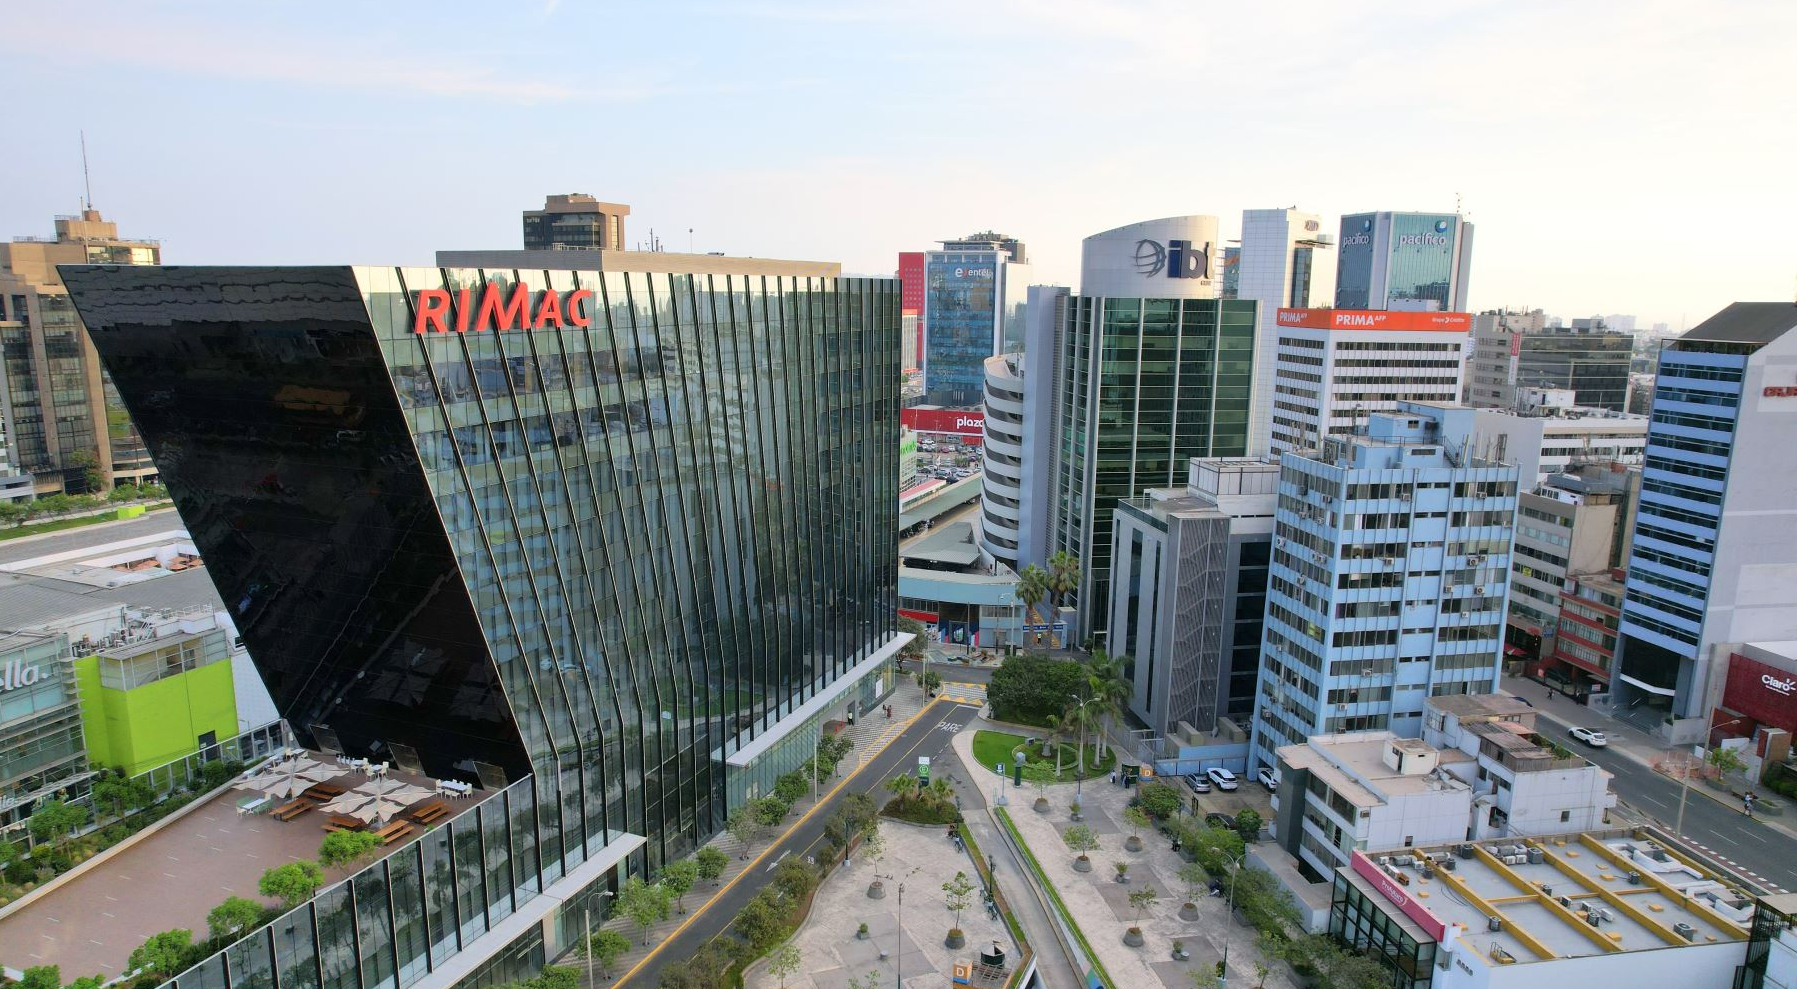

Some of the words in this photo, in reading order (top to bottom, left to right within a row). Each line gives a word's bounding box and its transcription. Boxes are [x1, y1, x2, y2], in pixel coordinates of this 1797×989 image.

[1167, 239, 1214, 279] ibt
[968, 268, 989, 277] entel
[414, 281, 593, 334] RIMAC
[1279, 311, 1301, 323] PRIMA
[1336, 314, 1375, 326] PRIMA
[0, 657, 49, 692] lla.
[1761, 674, 1791, 692] Claro
[936, 721, 963, 733] PARE
[956, 967, 965, 977] D
